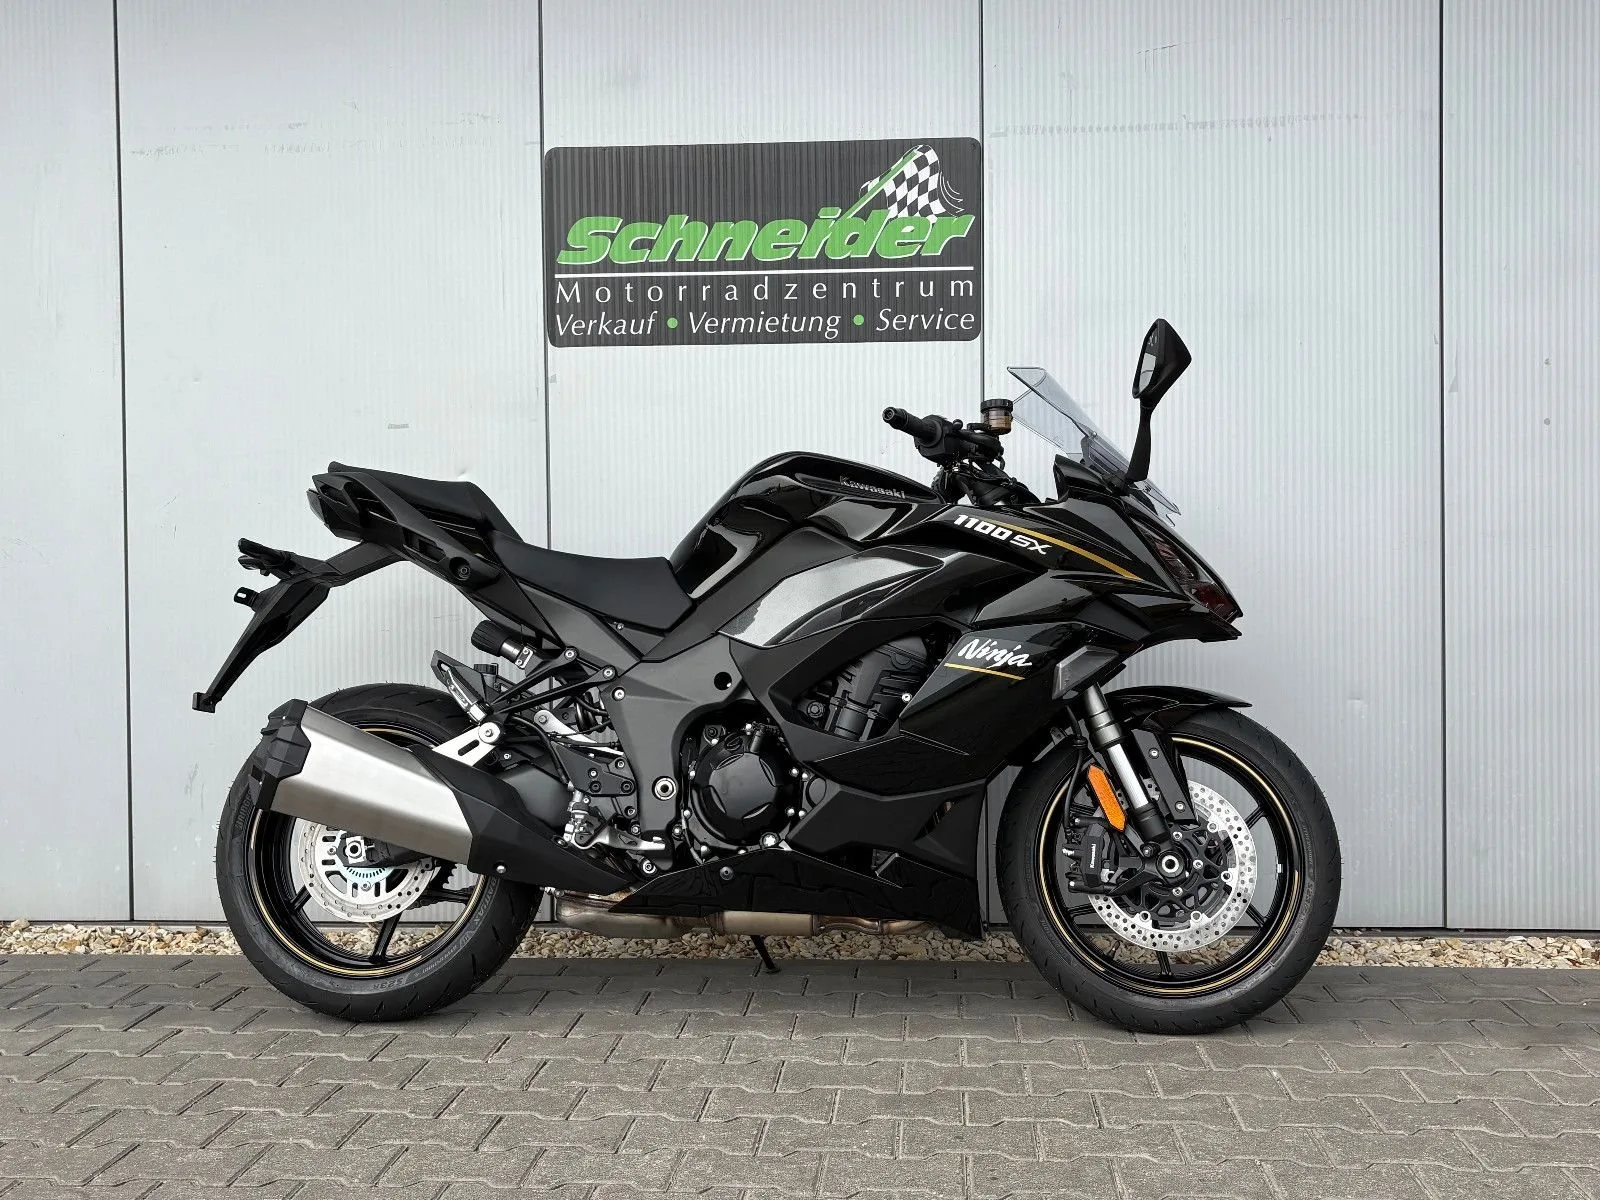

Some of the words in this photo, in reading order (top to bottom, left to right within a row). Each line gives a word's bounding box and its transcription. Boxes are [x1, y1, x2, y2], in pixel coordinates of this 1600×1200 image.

[556, 206, 975, 264] Schneider
[555, 276, 975, 304] Motorradzentrum
[556, 311, 657, 336] Verkauf
[688, 311, 841, 340] Vermietung
[876, 308, 975, 332] Service
[840, 476, 906, 499] Kawasaki
[954, 514, 1013, 541] 1100
[1011, 535, 1051, 555] SX
[957, 638, 1033, 668] Ninja
